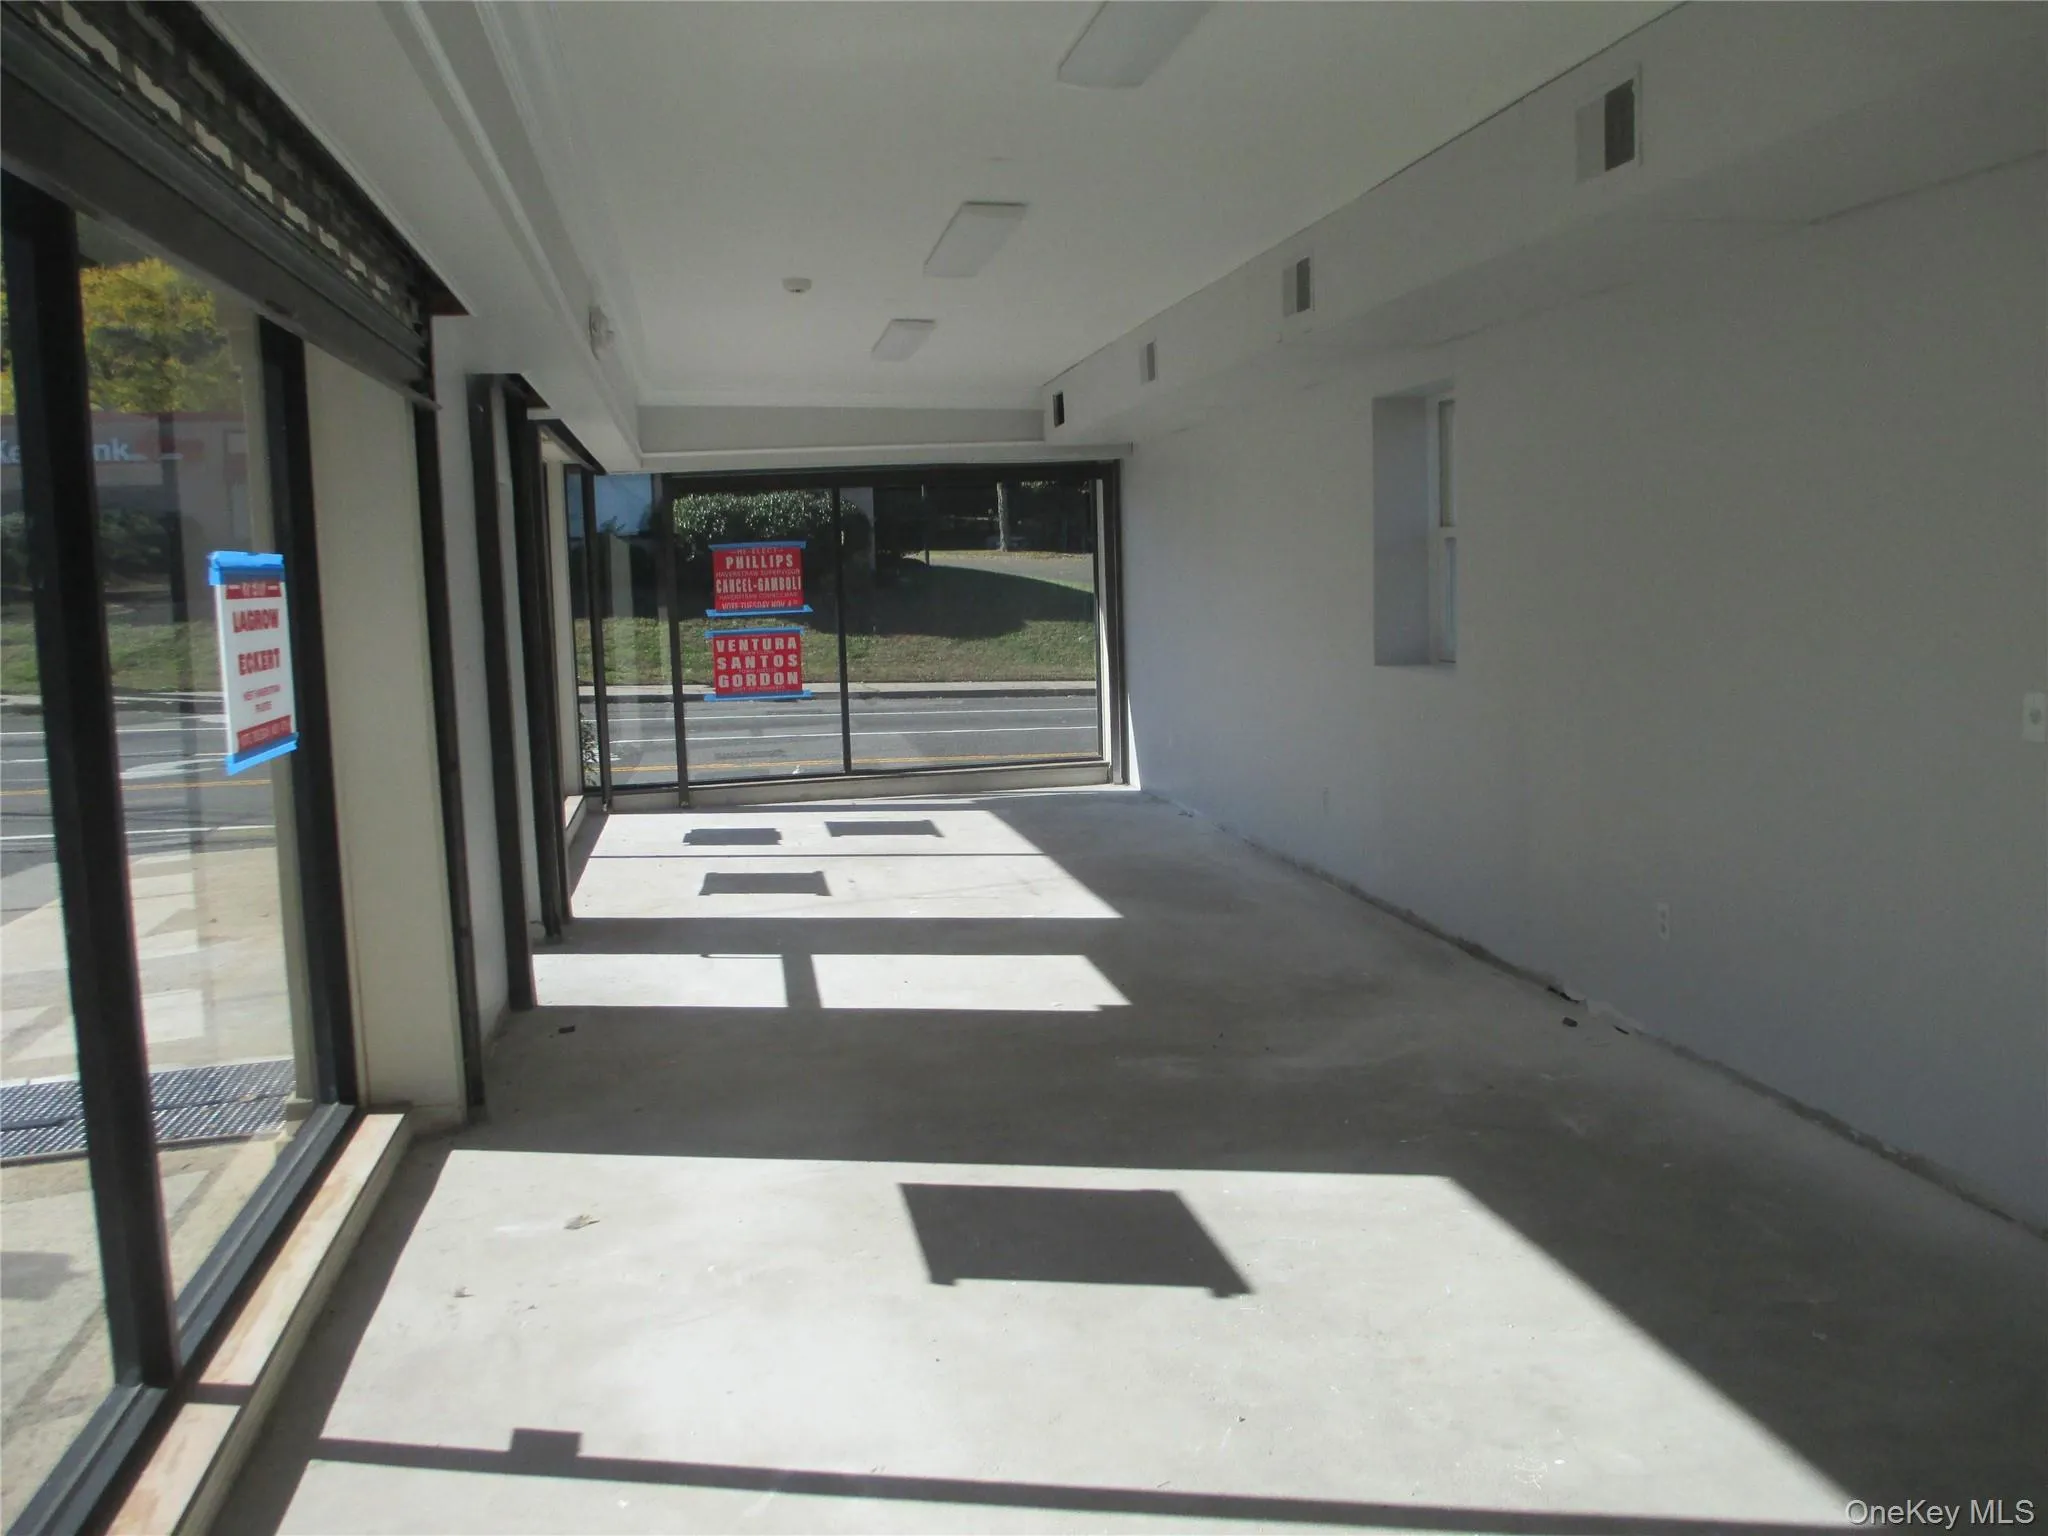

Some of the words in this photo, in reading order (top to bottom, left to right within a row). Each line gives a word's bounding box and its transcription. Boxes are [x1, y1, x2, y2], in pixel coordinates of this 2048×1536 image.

[725, 553, 793, 569] PHILLIPS
[716, 575, 801, 593] CANCEL-GAMBOLI
[716, 637, 797, 653] VENTURA
[238, 648, 280, 675] ECKERT
[717, 654, 798, 670] SANTOS
[718, 672, 798, 688] GORDON
